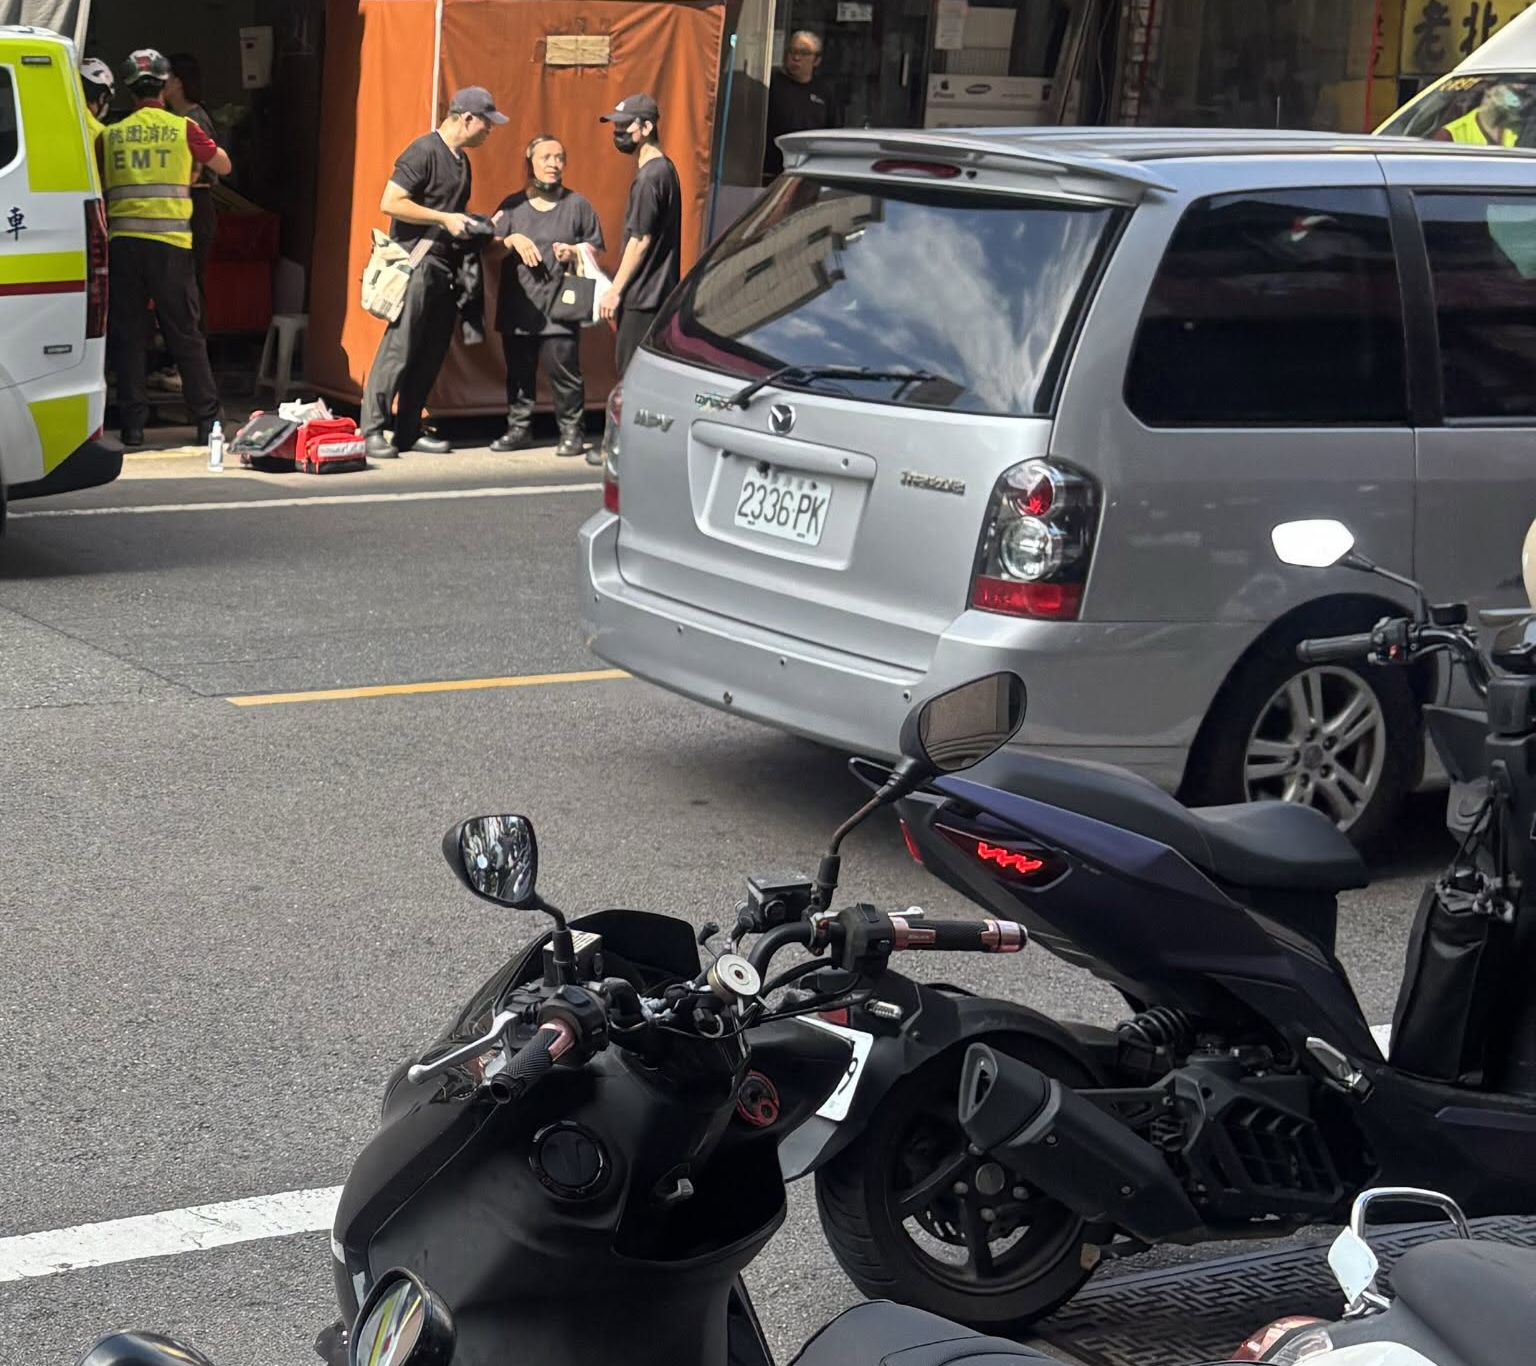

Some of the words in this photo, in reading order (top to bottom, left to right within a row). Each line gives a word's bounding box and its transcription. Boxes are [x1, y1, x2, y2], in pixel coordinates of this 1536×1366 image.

[109, 123, 180, 145] 桃園消防
[114, 149, 172, 170] EMT
